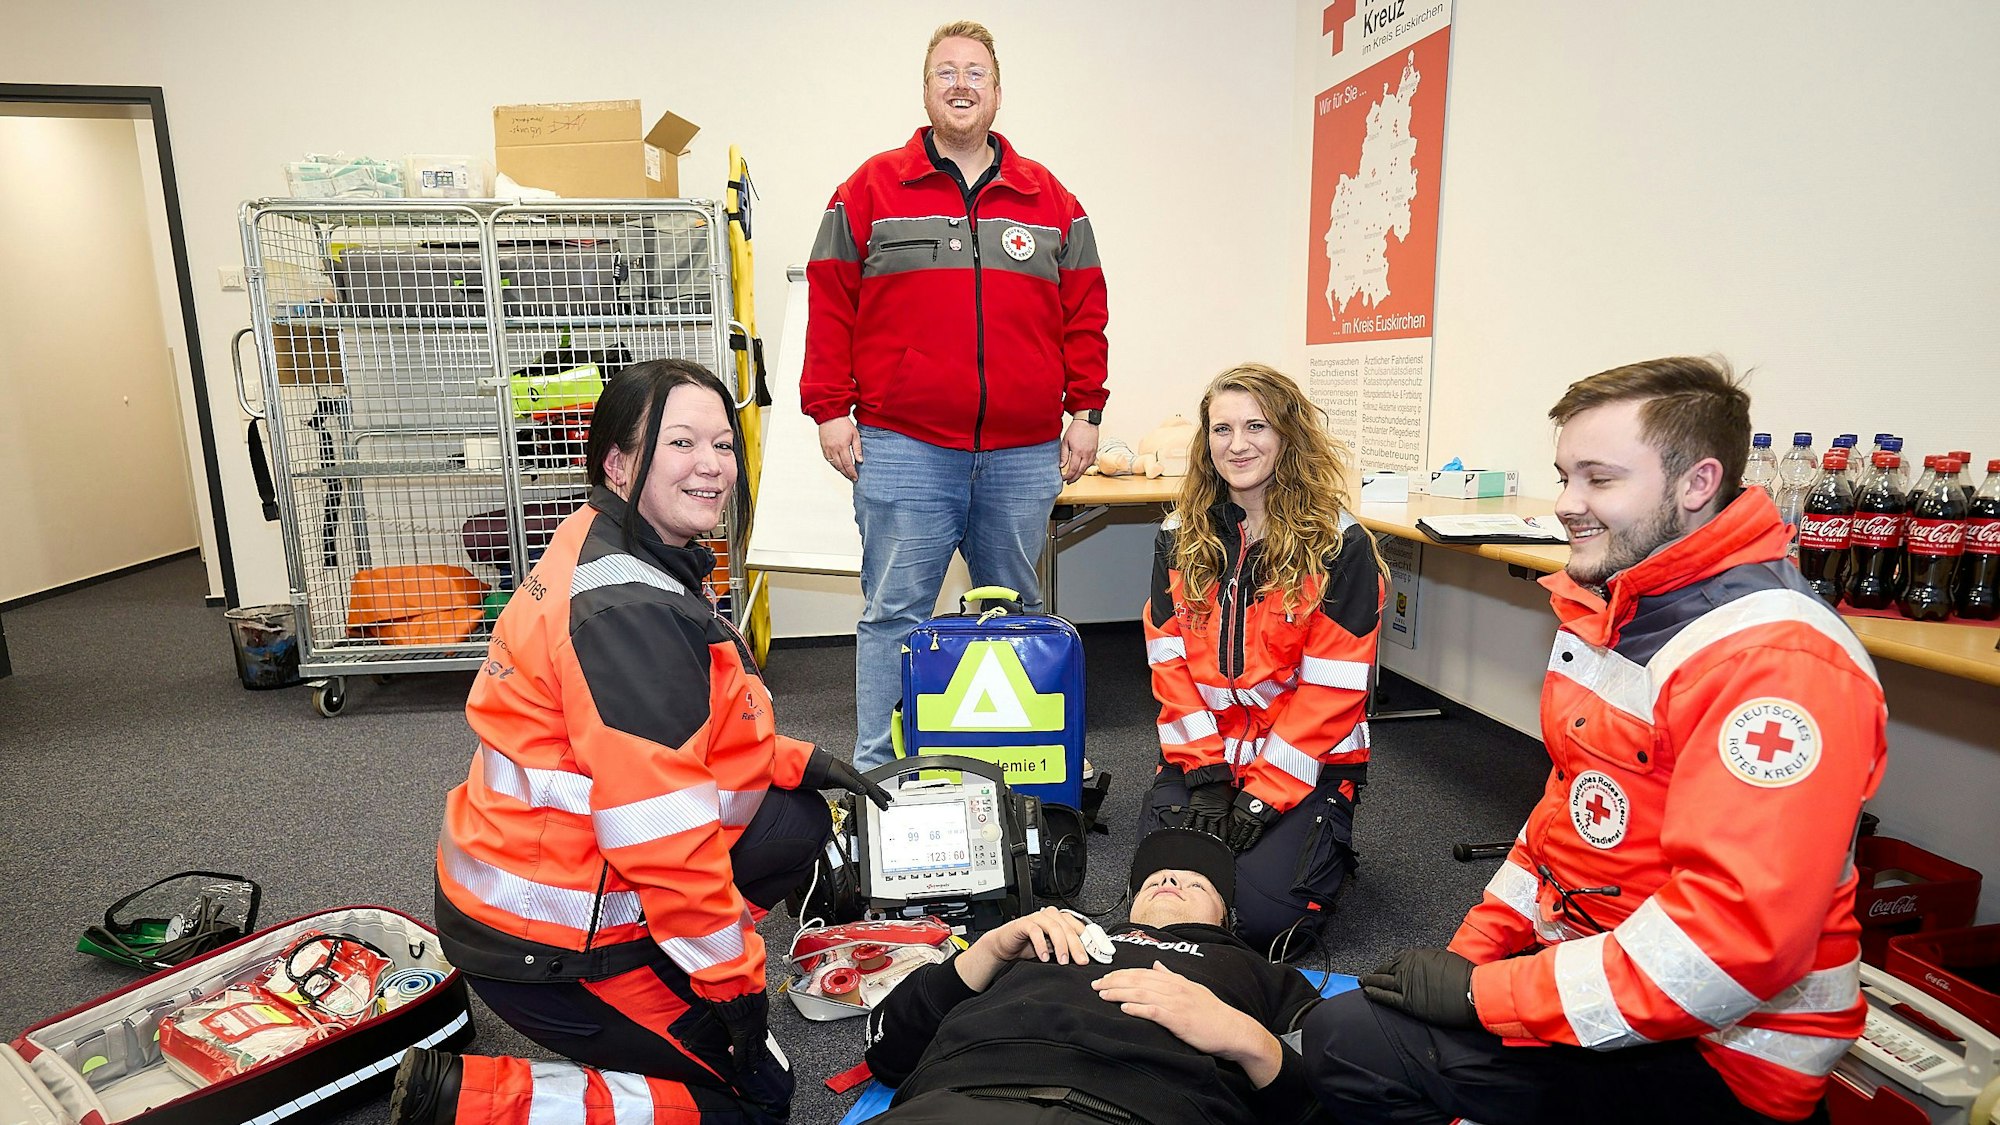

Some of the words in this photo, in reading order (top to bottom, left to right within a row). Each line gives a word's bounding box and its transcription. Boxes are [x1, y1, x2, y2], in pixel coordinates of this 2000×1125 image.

[1362, 45, 1371, 55] im
[1373, 31, 1393, 49] Kreis
[1396, 3, 1443, 37] Euskirchen
[1364, 0, 1405, 38] Kreuz
[1319, 97, 1332, 116] Wir
[1332, 92, 1344, 110] für
[1344, 84, 1358, 104] Sie
[1341, 319, 1352, 335] im
[1353, 316, 1374, 334] Kreis
[1375, 311, 1426, 332] Euskirchen
[1309, 357, 1359, 368] Rettungswachen
[1310, 368, 1358, 377] Suchdienst
[1361, 446, 1420, 463] Schulbetreuung
[1735, 704, 1811, 741] DEUTSCHES
[1040, 758, 1047, 771] 1
[1729, 738, 1757, 776] ROTES
[1763, 751, 1809, 779] KREUZ
[1572, 776, 1596, 807] Deutsches
[1598, 776, 1619, 798] Rotes
[1617, 797, 1626, 826] Kreuz
[908, 832, 919, 842] 99
[1574, 811, 1622, 845] Rettungsdienst
[953, 850, 965, 860] 60
